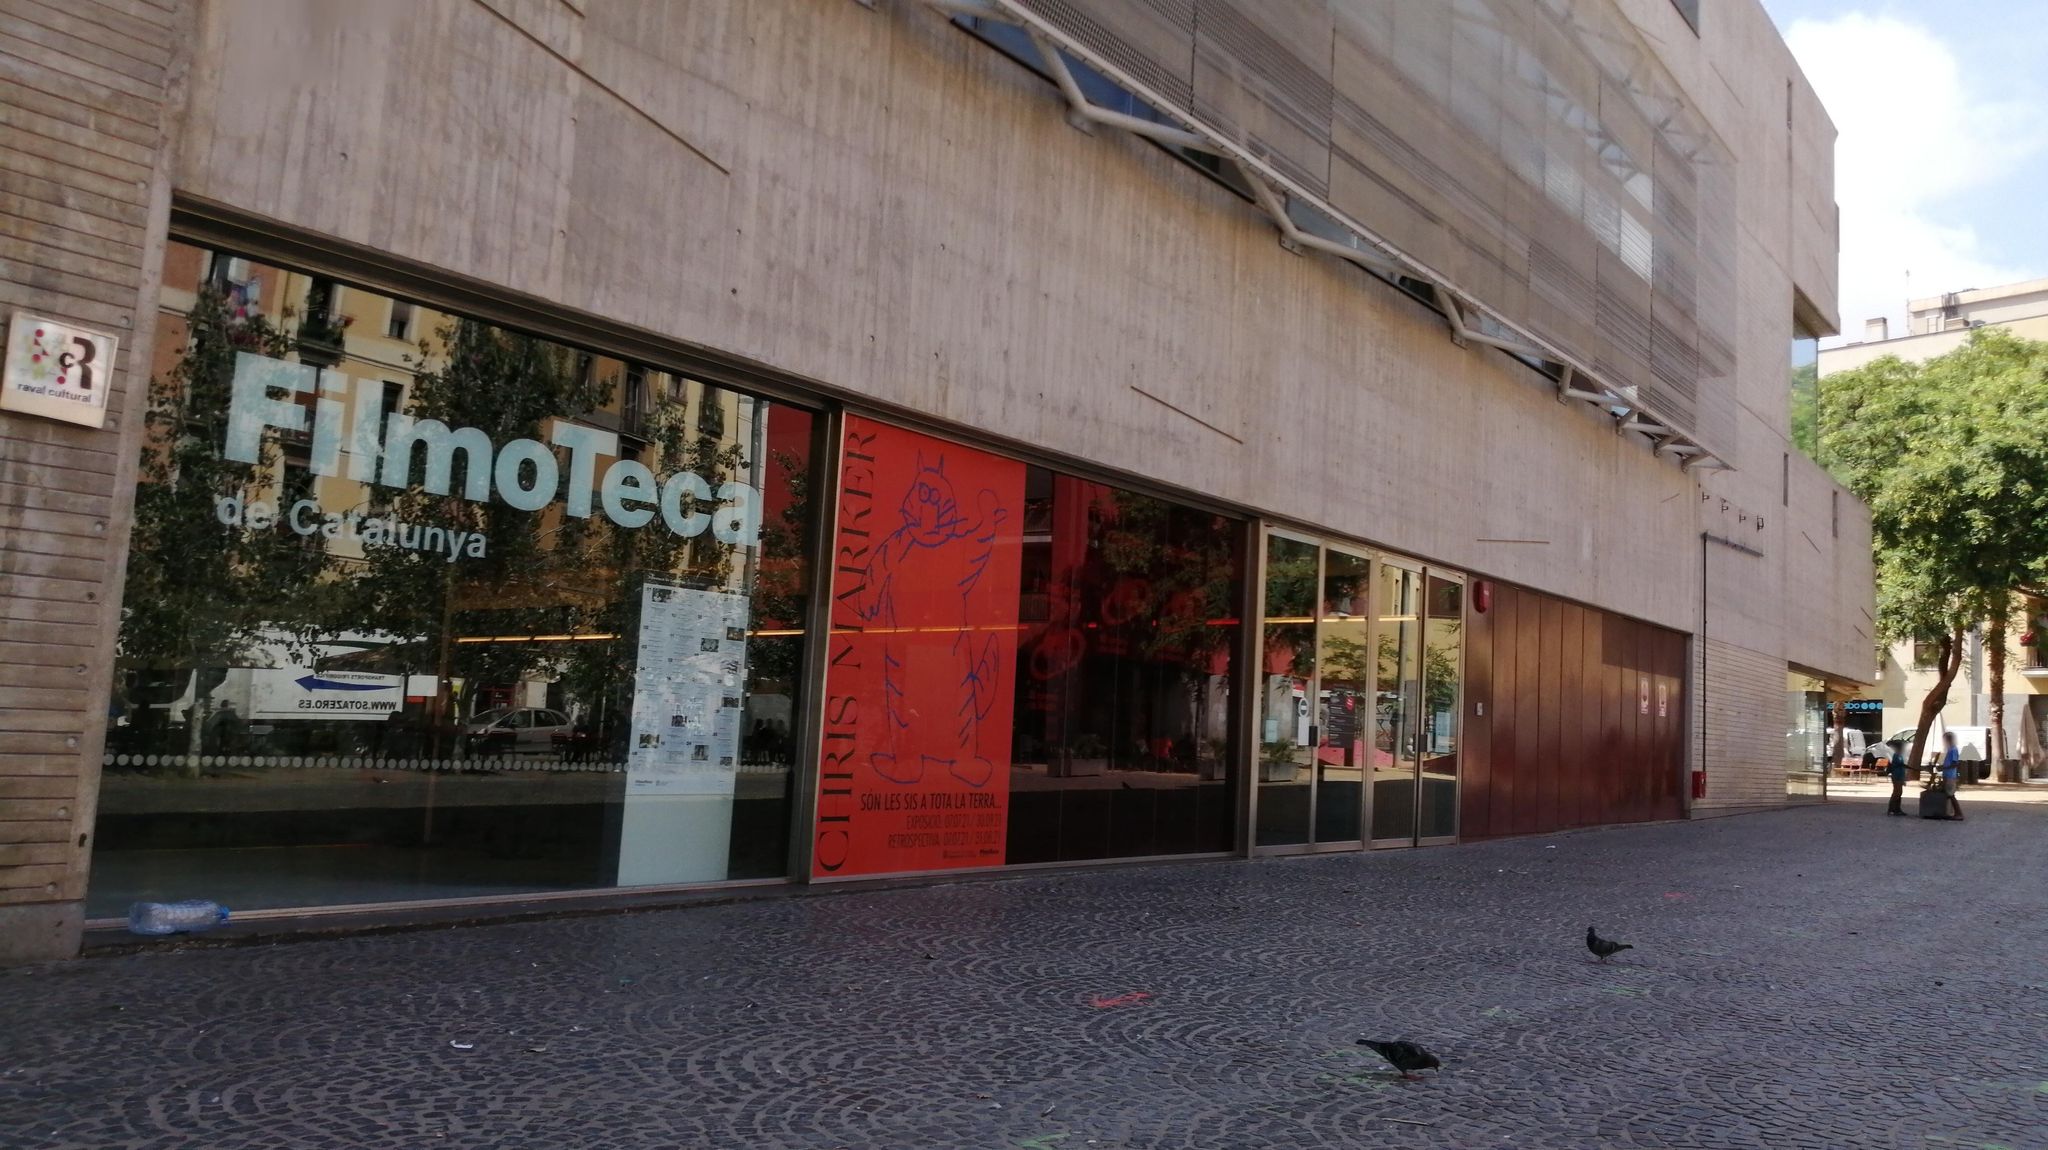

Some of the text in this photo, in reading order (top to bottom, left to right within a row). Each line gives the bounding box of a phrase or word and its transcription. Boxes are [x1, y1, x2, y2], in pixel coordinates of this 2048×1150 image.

[17, 383, 92, 403] raval cultural
[224, 350, 763, 547] FilmoTeca
[214, 485, 488, 563] de Catalunya
[818, 432, 877, 872] CHRIS MARKER
[860, 788, 881, 811] SÓN
[884, 793, 901, 811] LES
[904, 793, 918, 810] SIS
[920, 793, 928, 809] A
[930, 793, 952, 809] TOTA
[955, 792, 966, 809] LA
